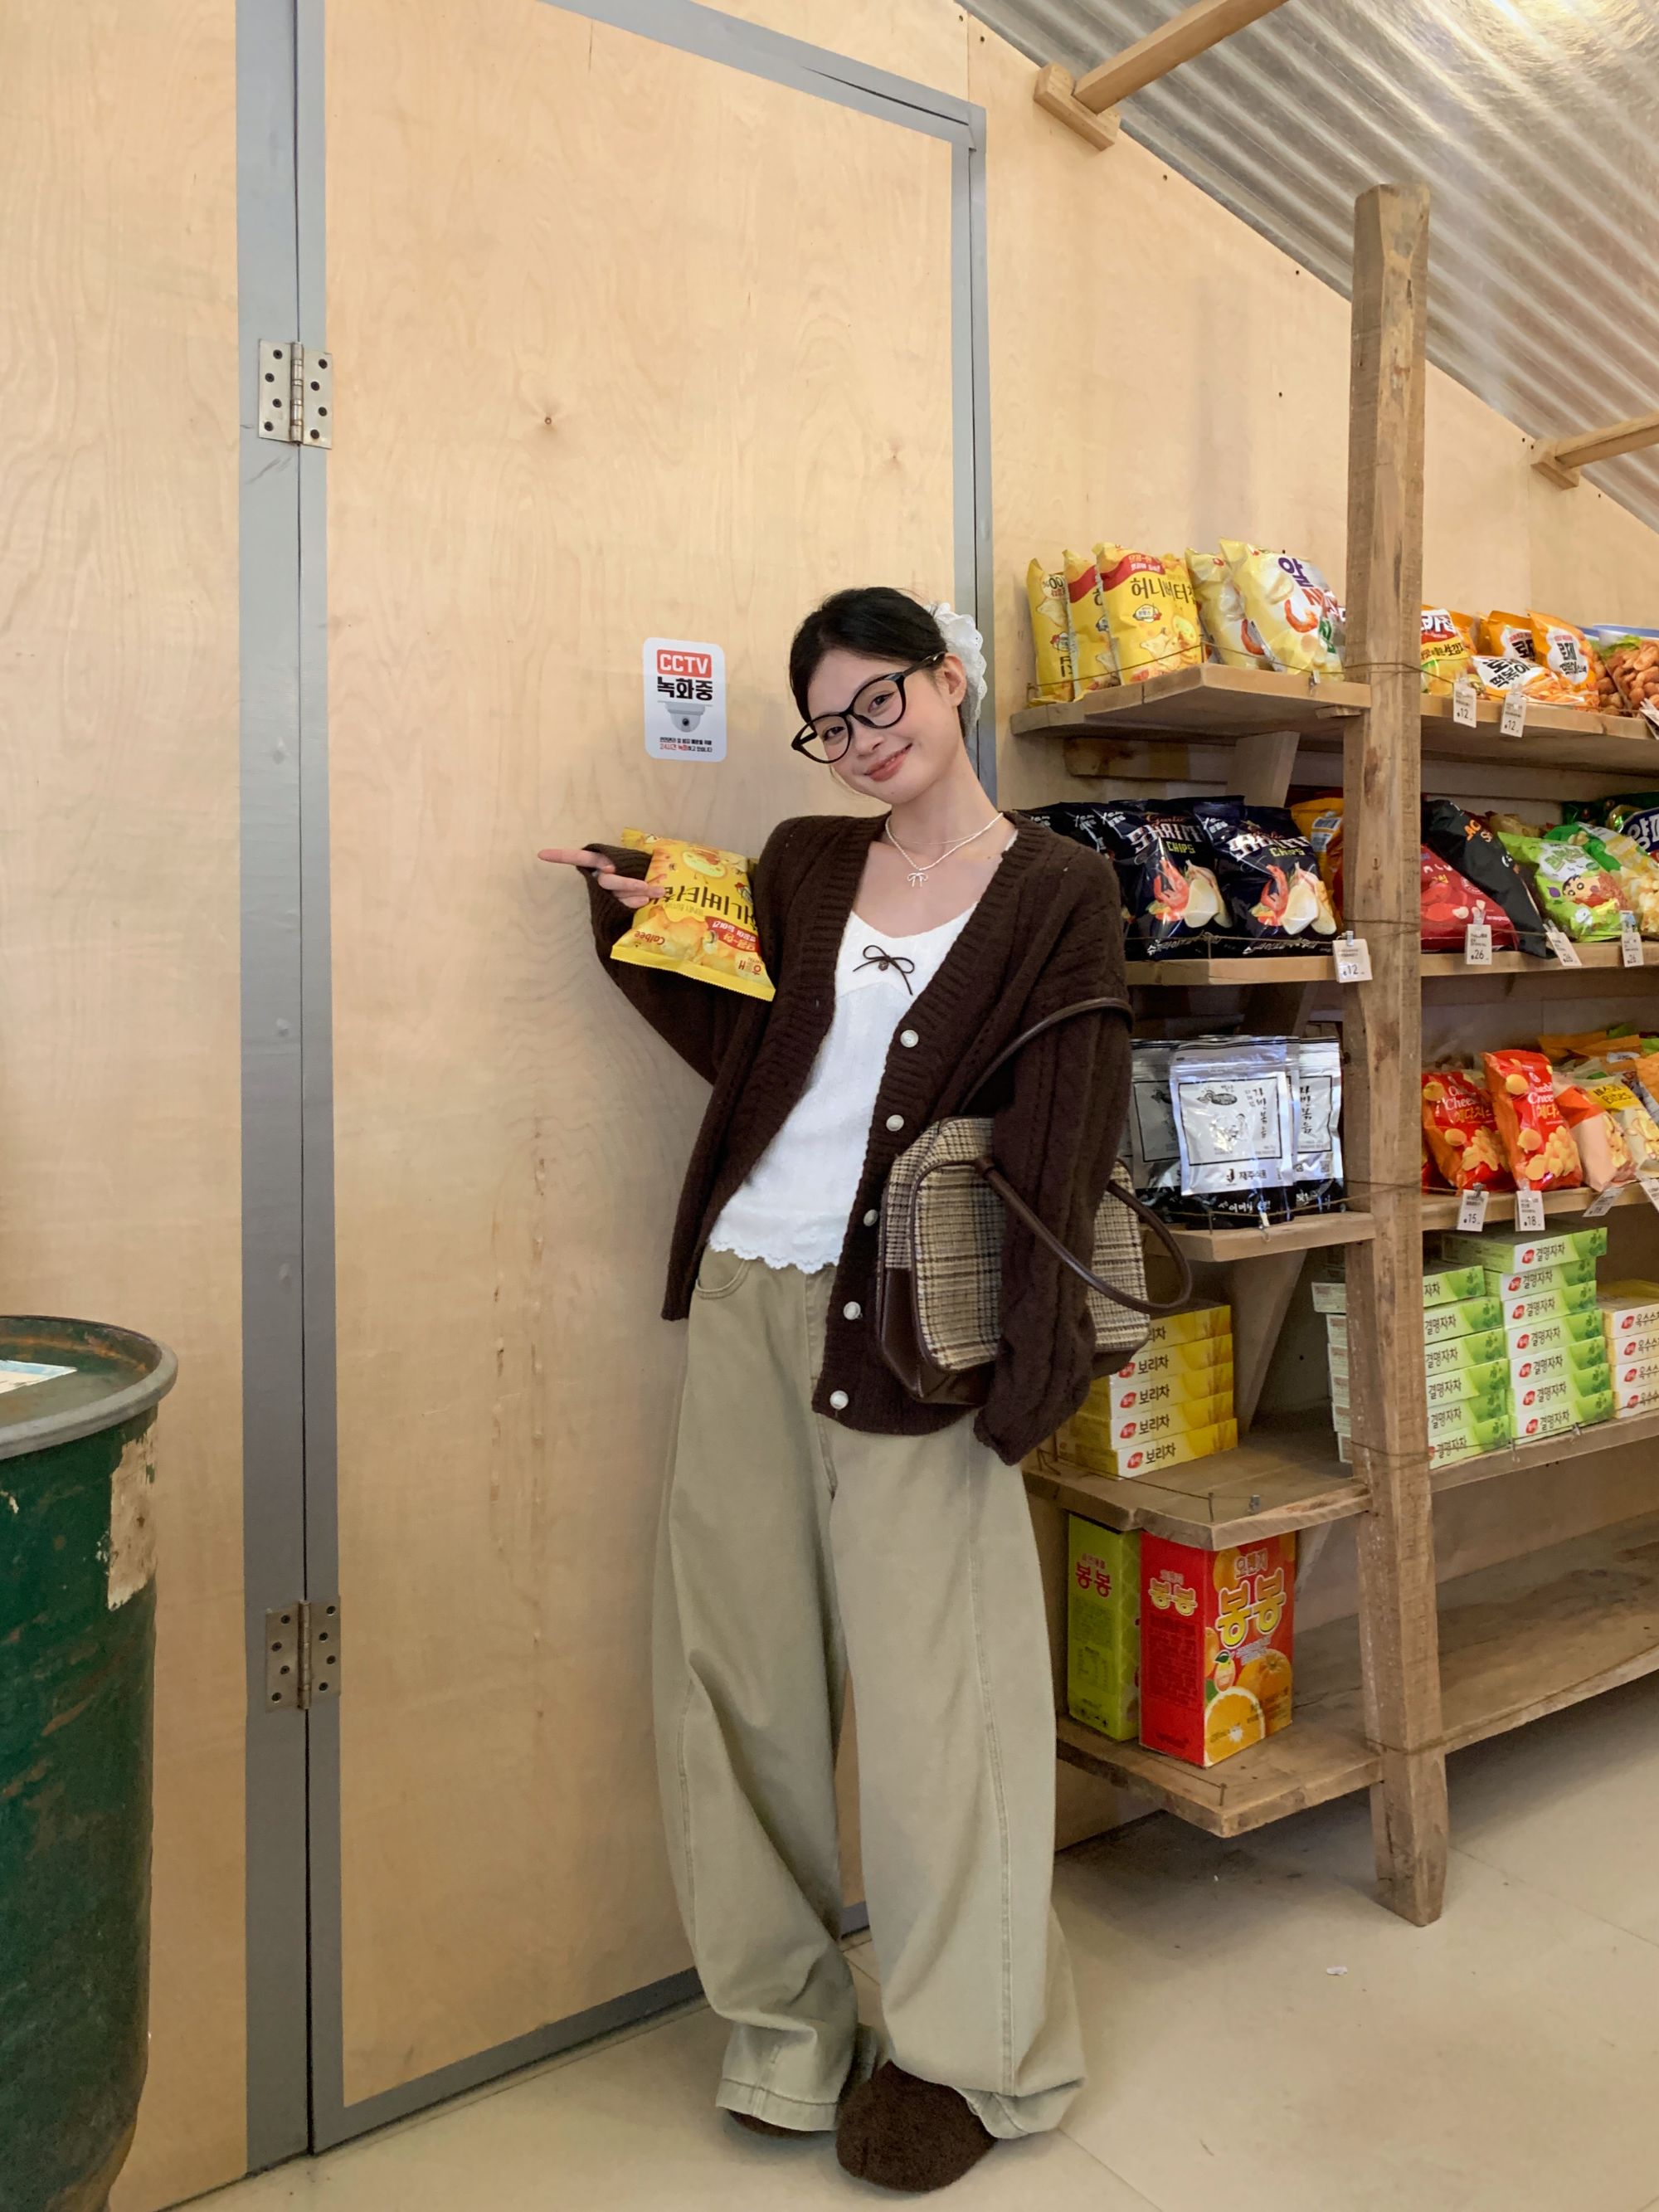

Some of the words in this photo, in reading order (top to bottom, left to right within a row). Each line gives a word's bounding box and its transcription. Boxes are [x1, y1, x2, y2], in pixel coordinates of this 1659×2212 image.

[659, 653, 709, 675] CCTV
[657, 675, 713, 702] 녹화중
[1127, 823, 1204, 855] SHRIM
[1165, 840, 1196, 854] CHIPS
[634, 930, 665, 946] Calbee
[1444, 1095, 1477, 1111] Chees
[1537, 1103, 1559, 1119] 체다
[1535, 1243, 1565, 1262] 결명자차
[1423, 1281, 1441, 1298] 자차
[1522, 1269, 1553, 1289] 결명자차
[1526, 1297, 1555, 1318] 결명자차
[1424, 1313, 1457, 1336] 결명자차
[1635, 1311, 1659, 1328] 옥수수
[1147, 1326, 1167, 1342] 리차
[1530, 1327, 1561, 1347] 결명자차
[1637, 1337, 1659, 1354] 옥수수
[1138, 1354, 1170, 1375] 보리차
[1425, 1347, 1458, 1369] 결명자차
[1534, 1354, 1564, 1376] 결명자차
[1639, 1364, 1659, 1380] 옥수수
[1139, 1383, 1170, 1405] 보리차
[1428, 1378, 1462, 1401] 결명자차
[1536, 1381, 1567, 1403] 결명자차
[1641, 1390, 1659, 1406] 옥수수
[1139, 1414, 1170, 1435] 보리차
[1431, 1406, 1462, 1429] 결명자차
[1540, 1410, 1570, 1431] 결명자차
[1146, 1442, 1177, 1464] 보리차
[1437, 1435, 1467, 1459] 결명자차
[1075, 1561, 1113, 1598] 봉봉
[1148, 1577, 1199, 1617] 봉봉
[1214, 1566, 1287, 1650] 봉봉
